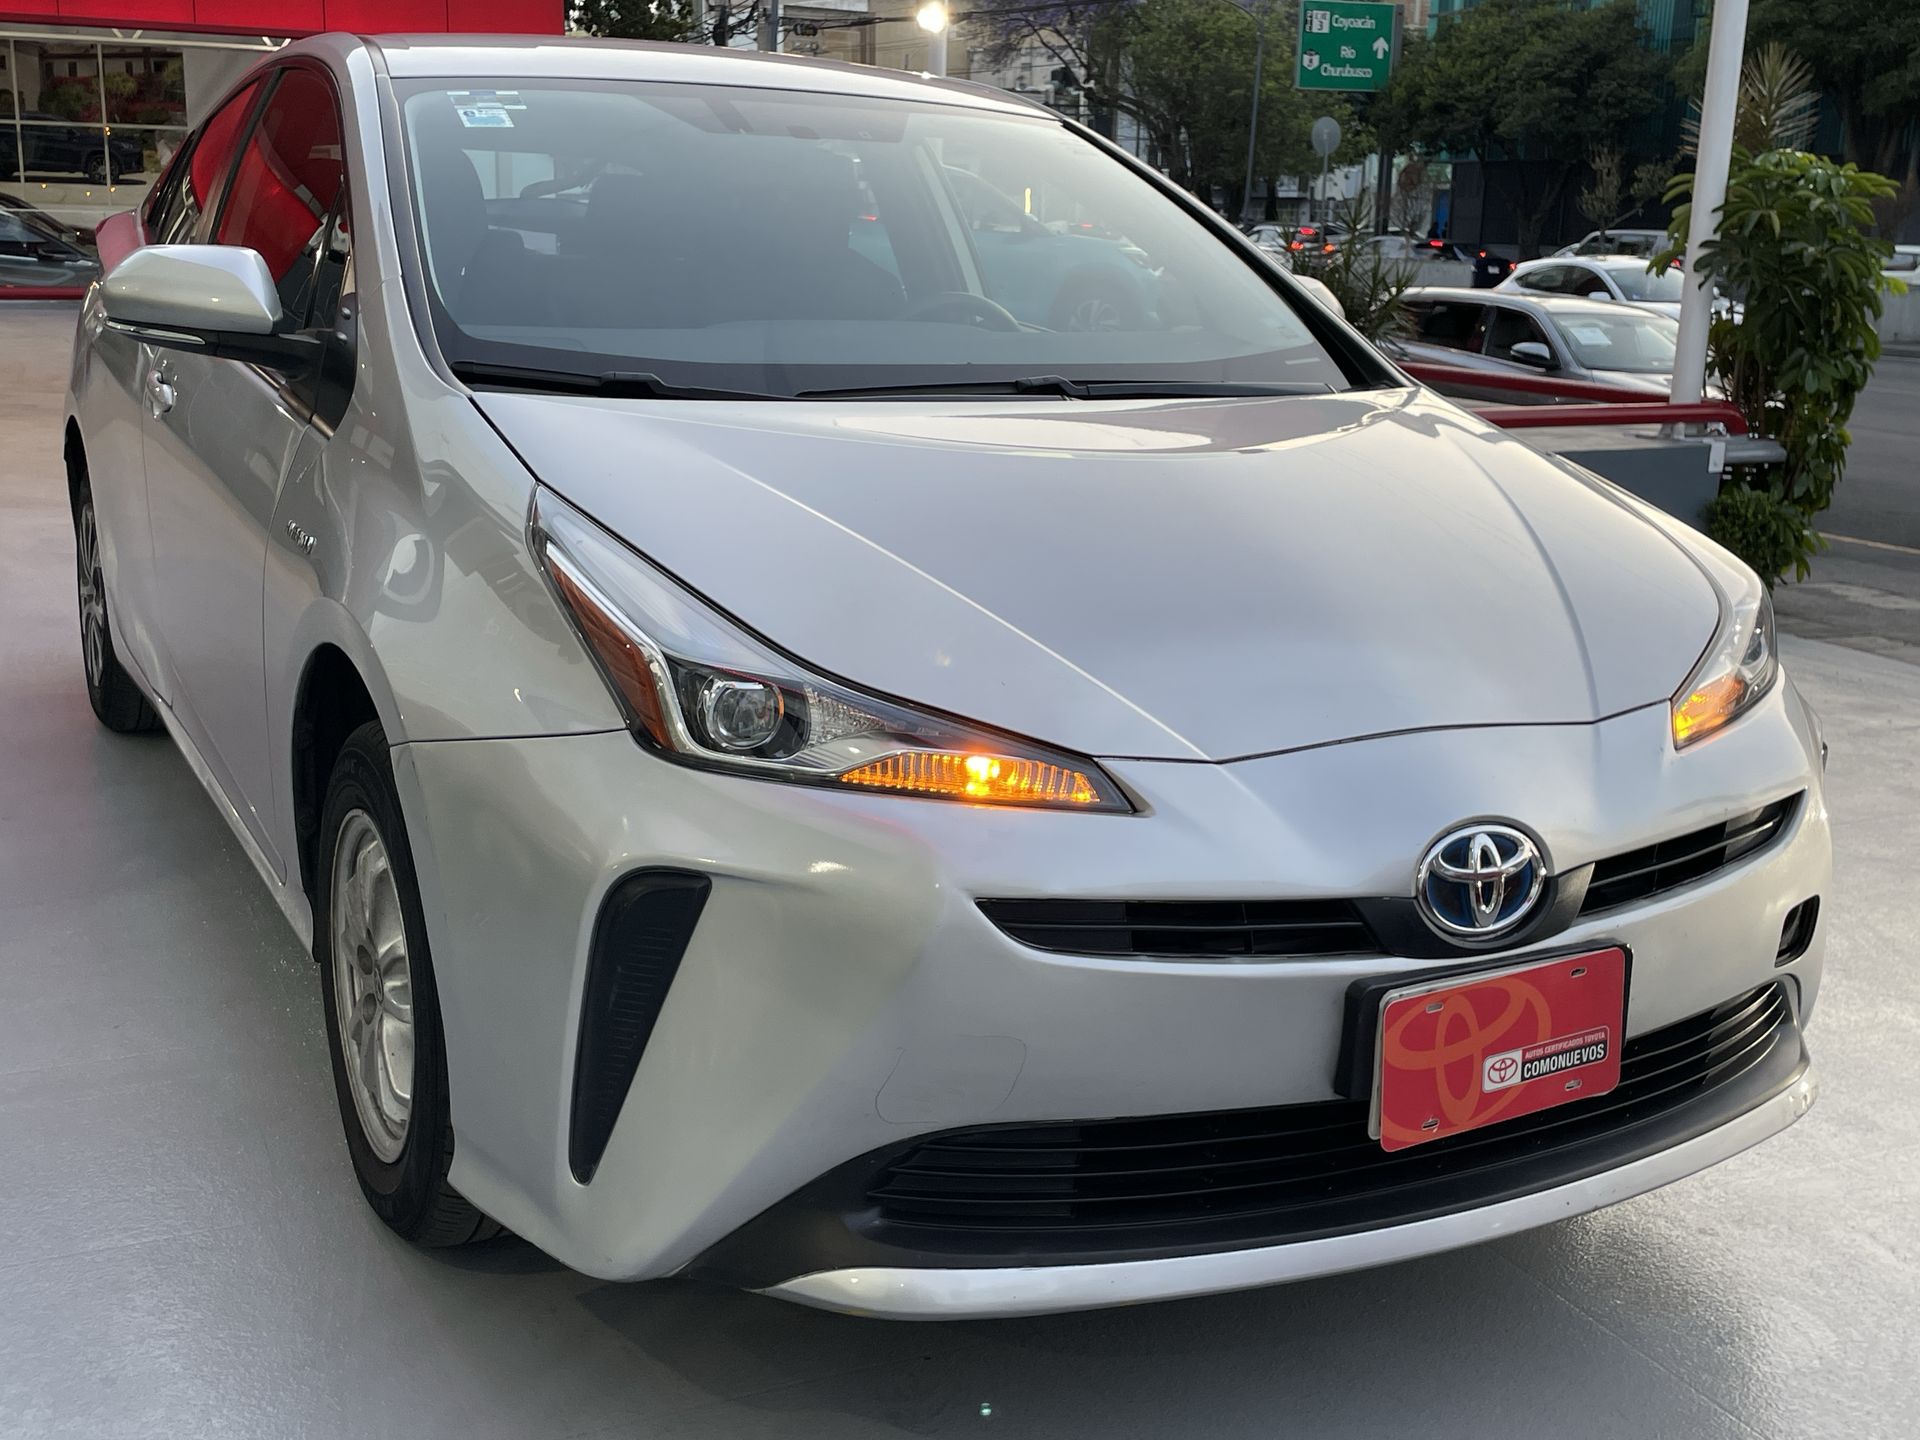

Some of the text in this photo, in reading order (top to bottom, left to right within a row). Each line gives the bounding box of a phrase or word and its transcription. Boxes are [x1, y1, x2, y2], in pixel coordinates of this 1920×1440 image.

[1331, 14, 1376, 31] Coyoacán
[1340, 45, 1356, 59] Río
[1320, 63, 1373, 78] Churubusco
[1525, 1031, 1606, 1059] AUTOS CERTIFICADOS TOYOTA
[1524, 1044, 1605, 1078] COMONUEVOS
